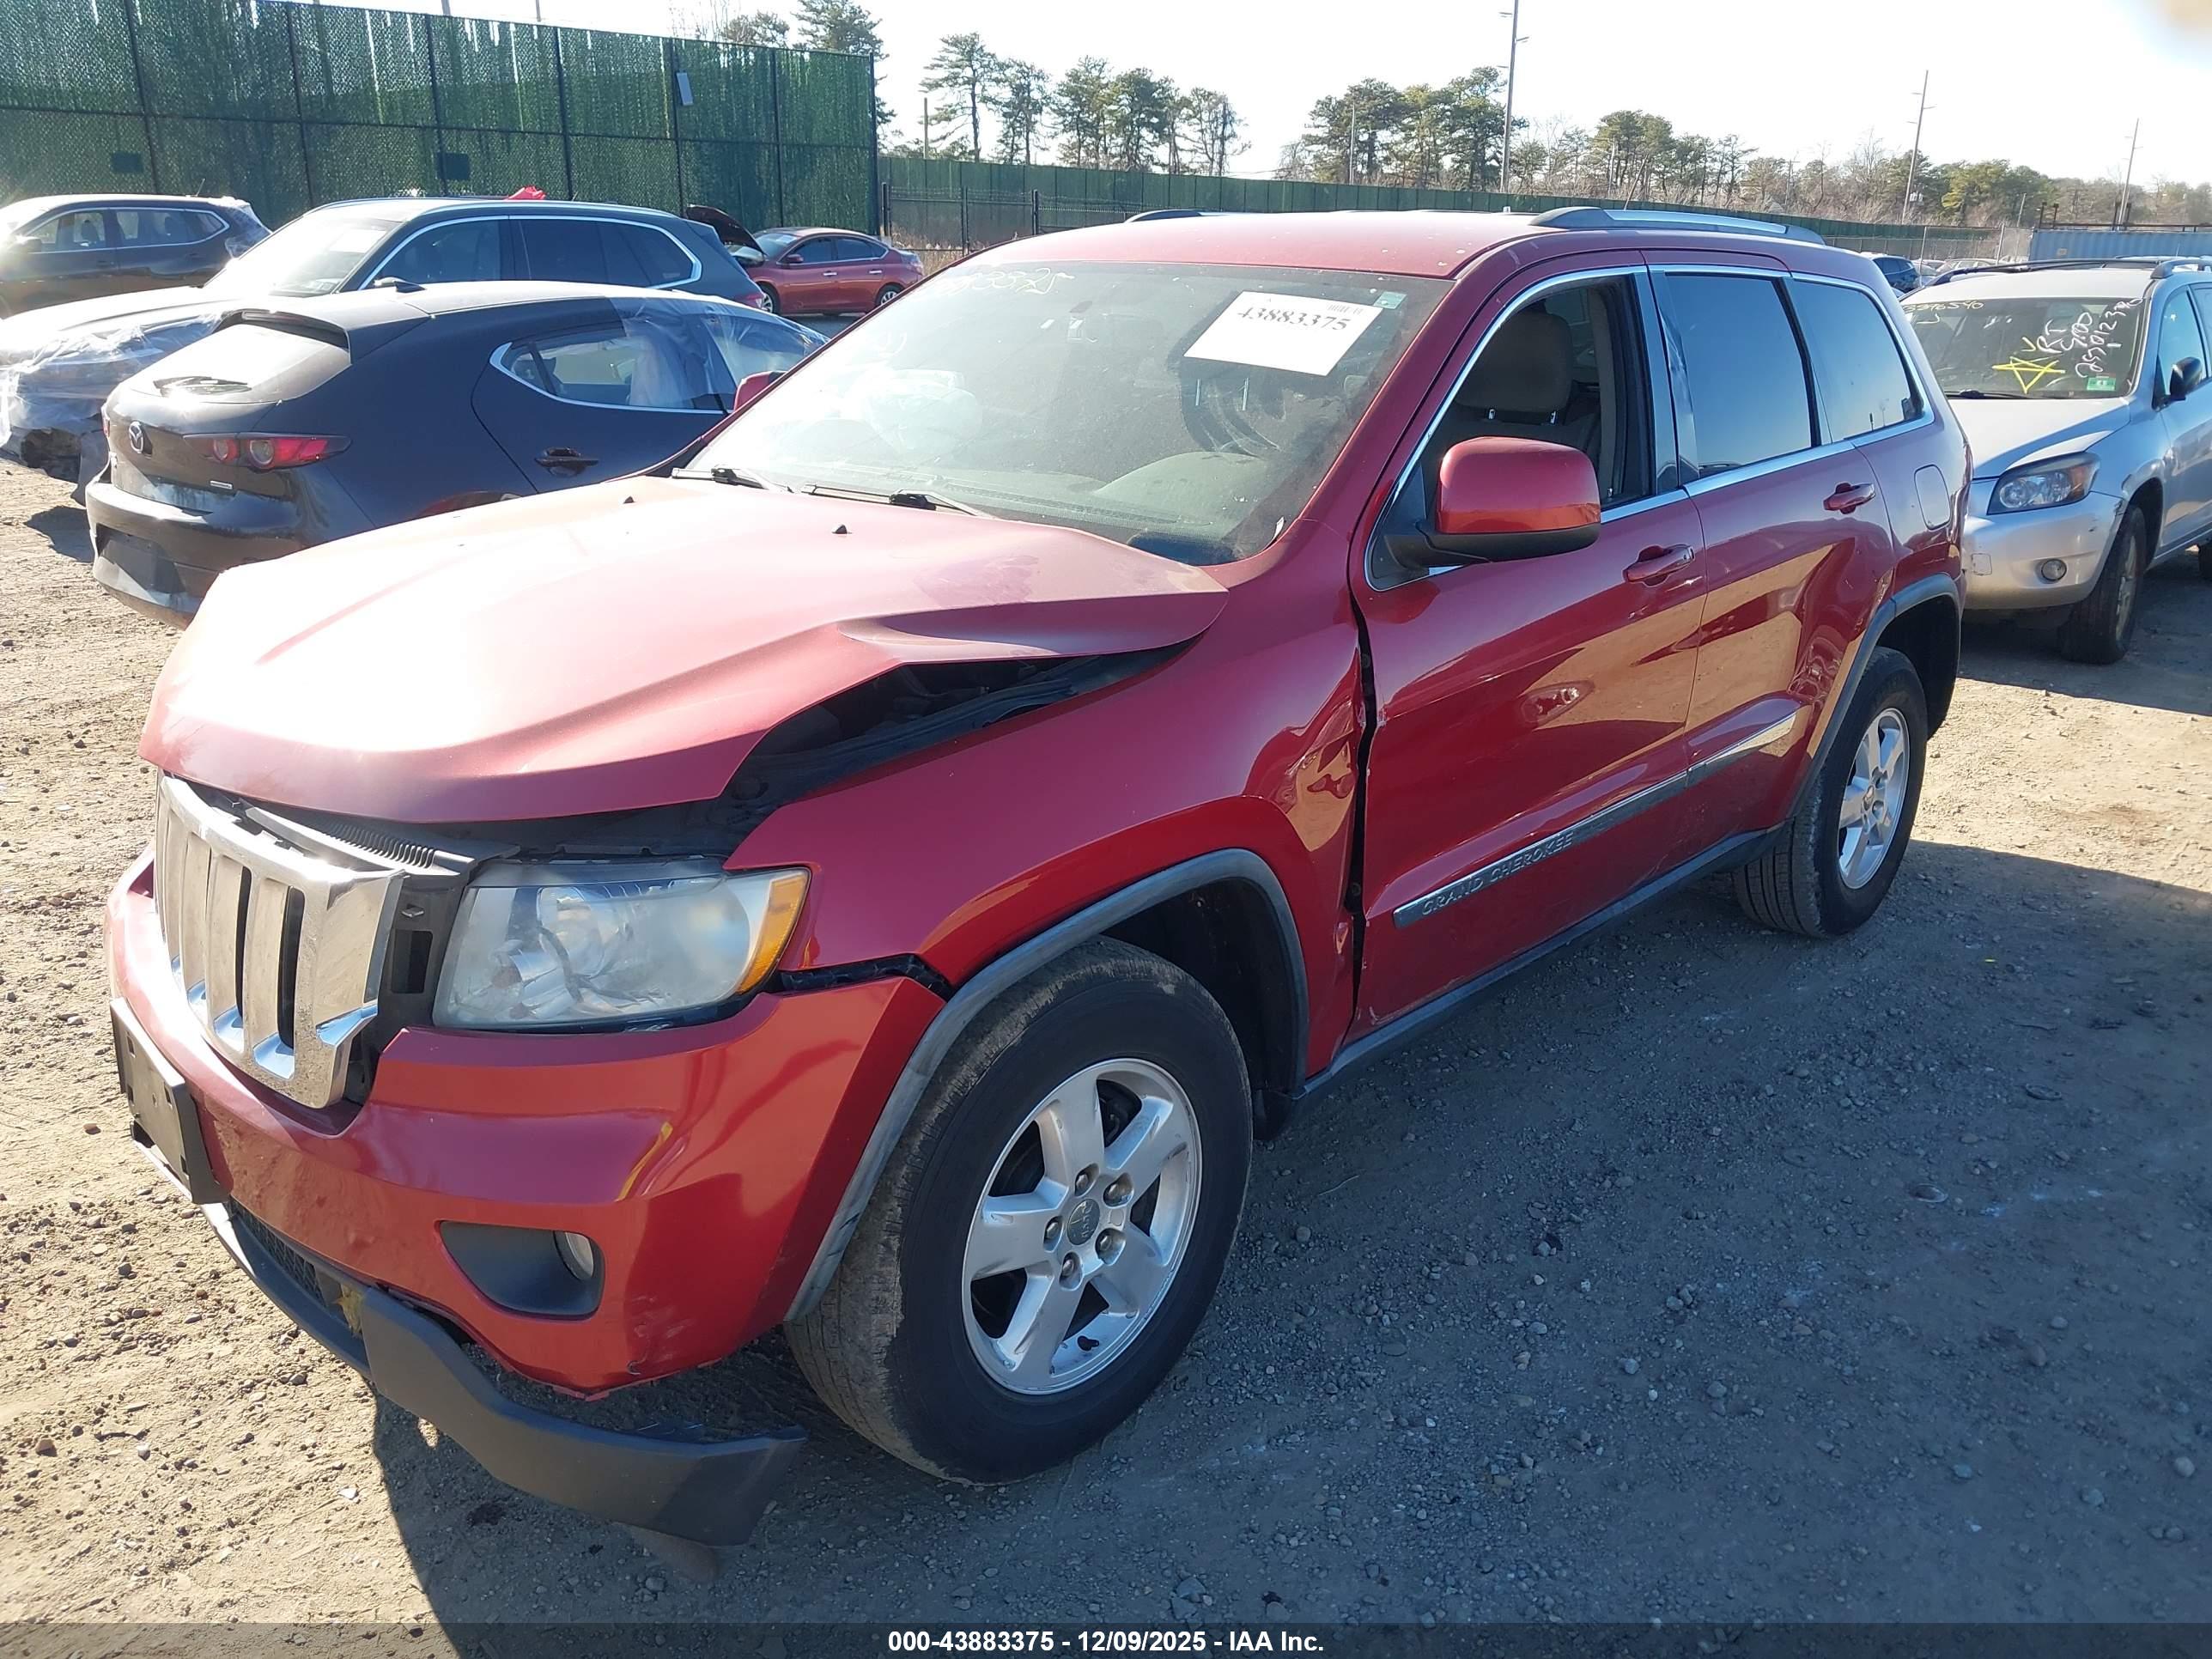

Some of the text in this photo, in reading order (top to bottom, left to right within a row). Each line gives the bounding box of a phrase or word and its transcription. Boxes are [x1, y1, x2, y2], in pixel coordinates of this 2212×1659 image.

[1238, 306, 1352, 331] 43883375
[1422, 832, 1574, 916] GRAND CHEROKEE
